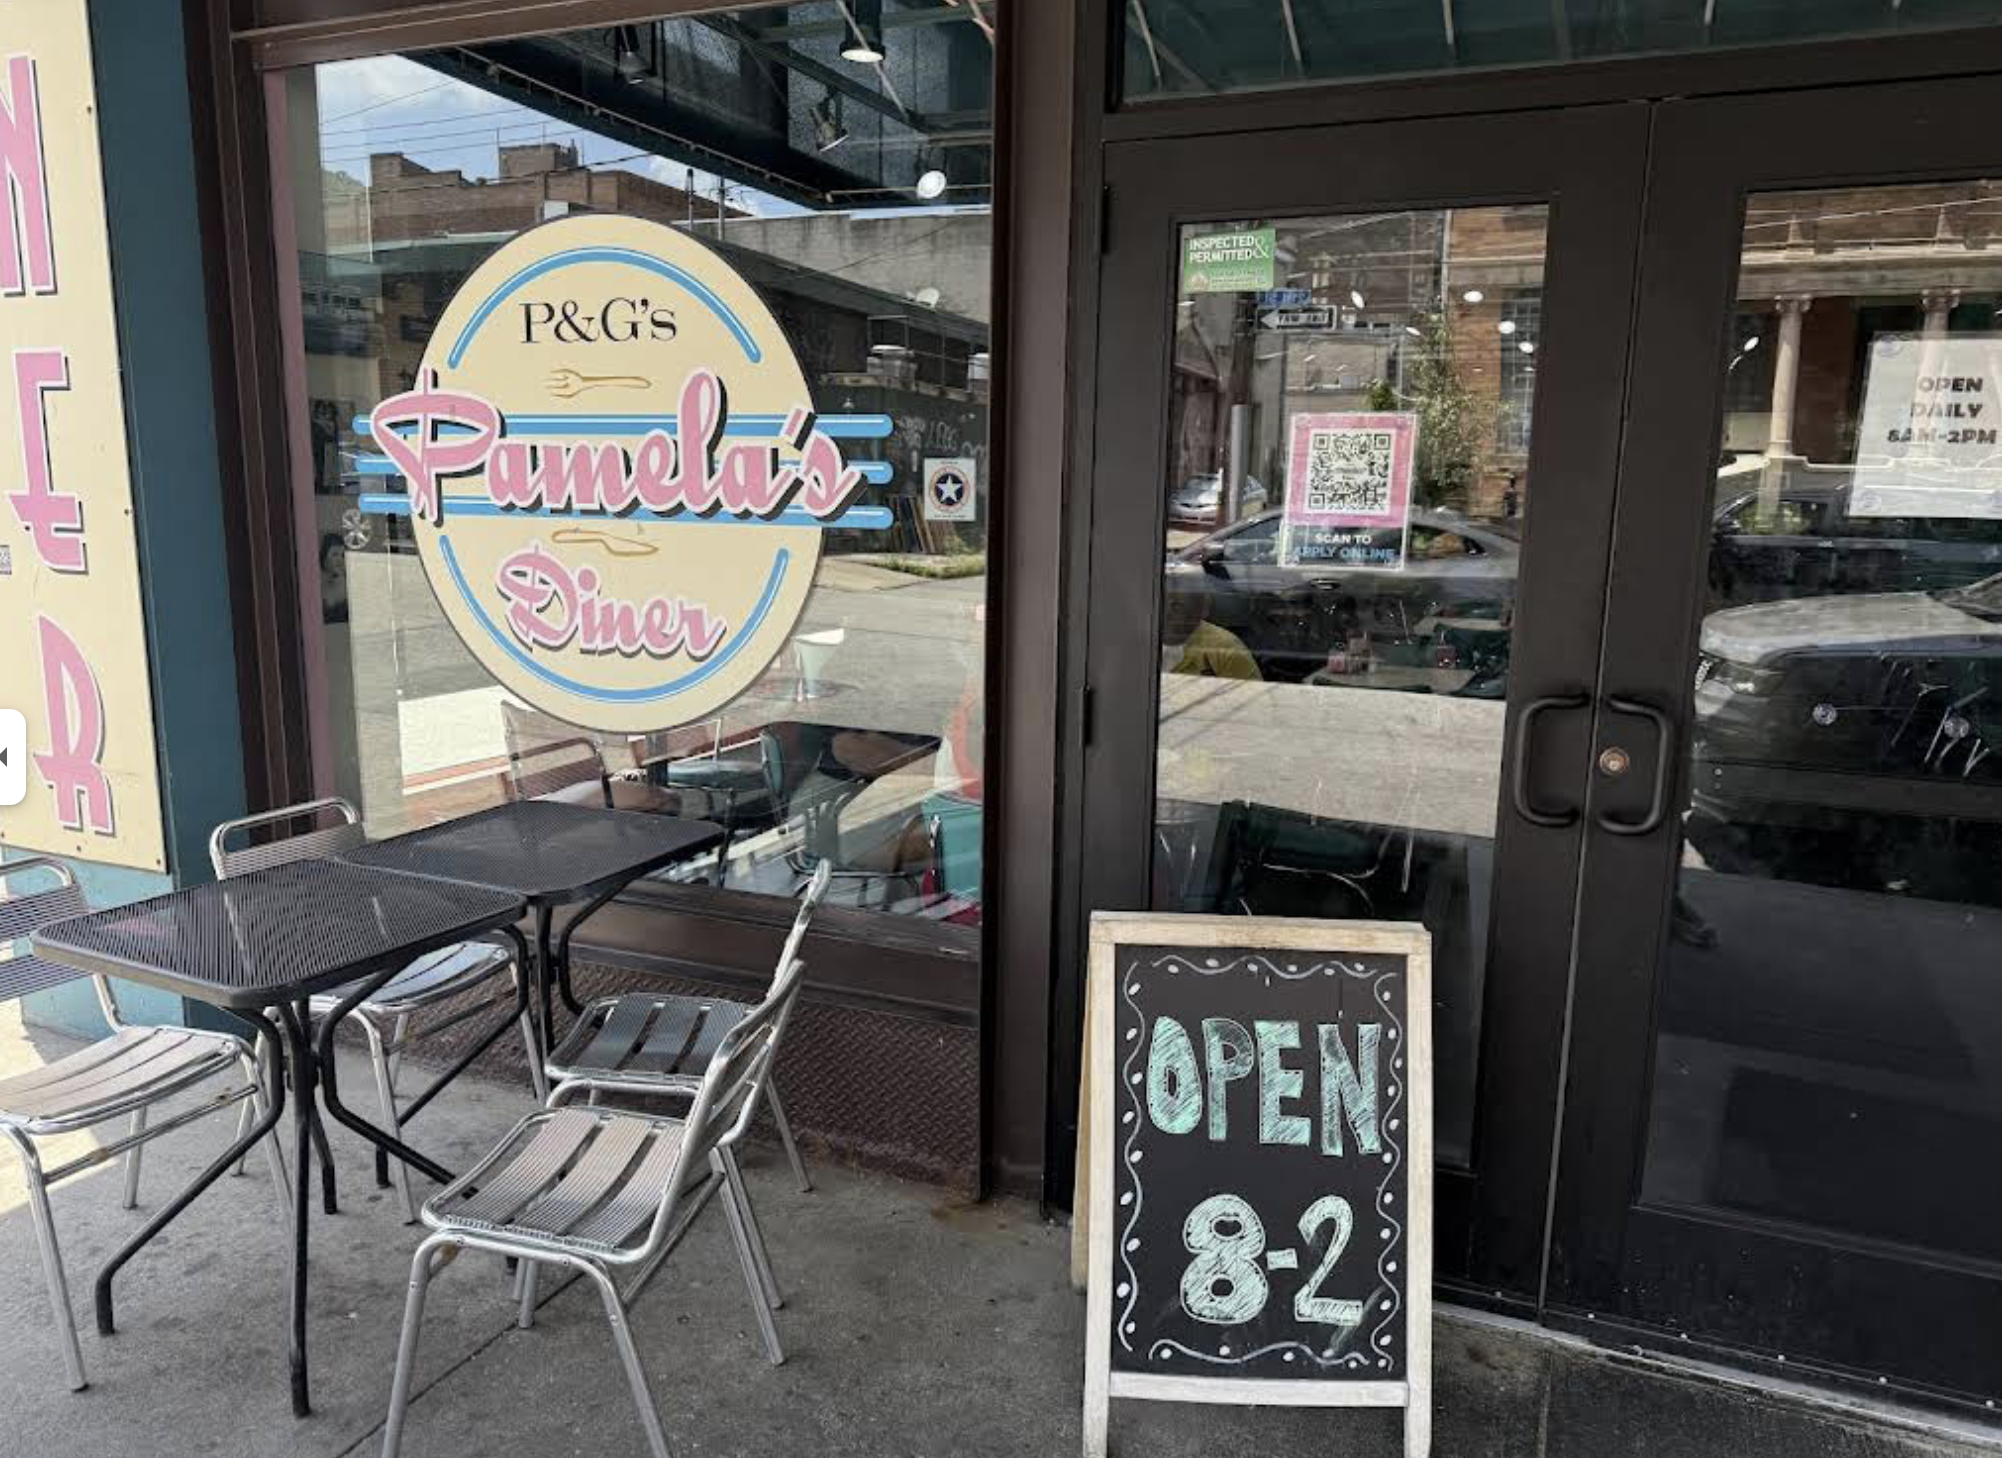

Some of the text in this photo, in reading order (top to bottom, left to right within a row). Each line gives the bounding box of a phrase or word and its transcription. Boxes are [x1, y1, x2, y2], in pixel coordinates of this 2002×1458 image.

[1189, 235, 1254, 251] INSPECTED
[1189, 249, 1252, 264] PERMITTED
[520, 296, 679, 344] P&G's
[1918, 376, 1983, 392] OPEN
[1911, 402, 1983, 418] DAILY
[371, 367, 868, 527] Pamela's
[1315, 533, 1372, 545] SCAN TO
[1293, 546, 1396, 560] APPLY ONLINE
[497, 545, 727, 663] Diner
[1146, 1015, 1384, 1157] OPEN
[1180, 1193, 1364, 1327] 8-2
